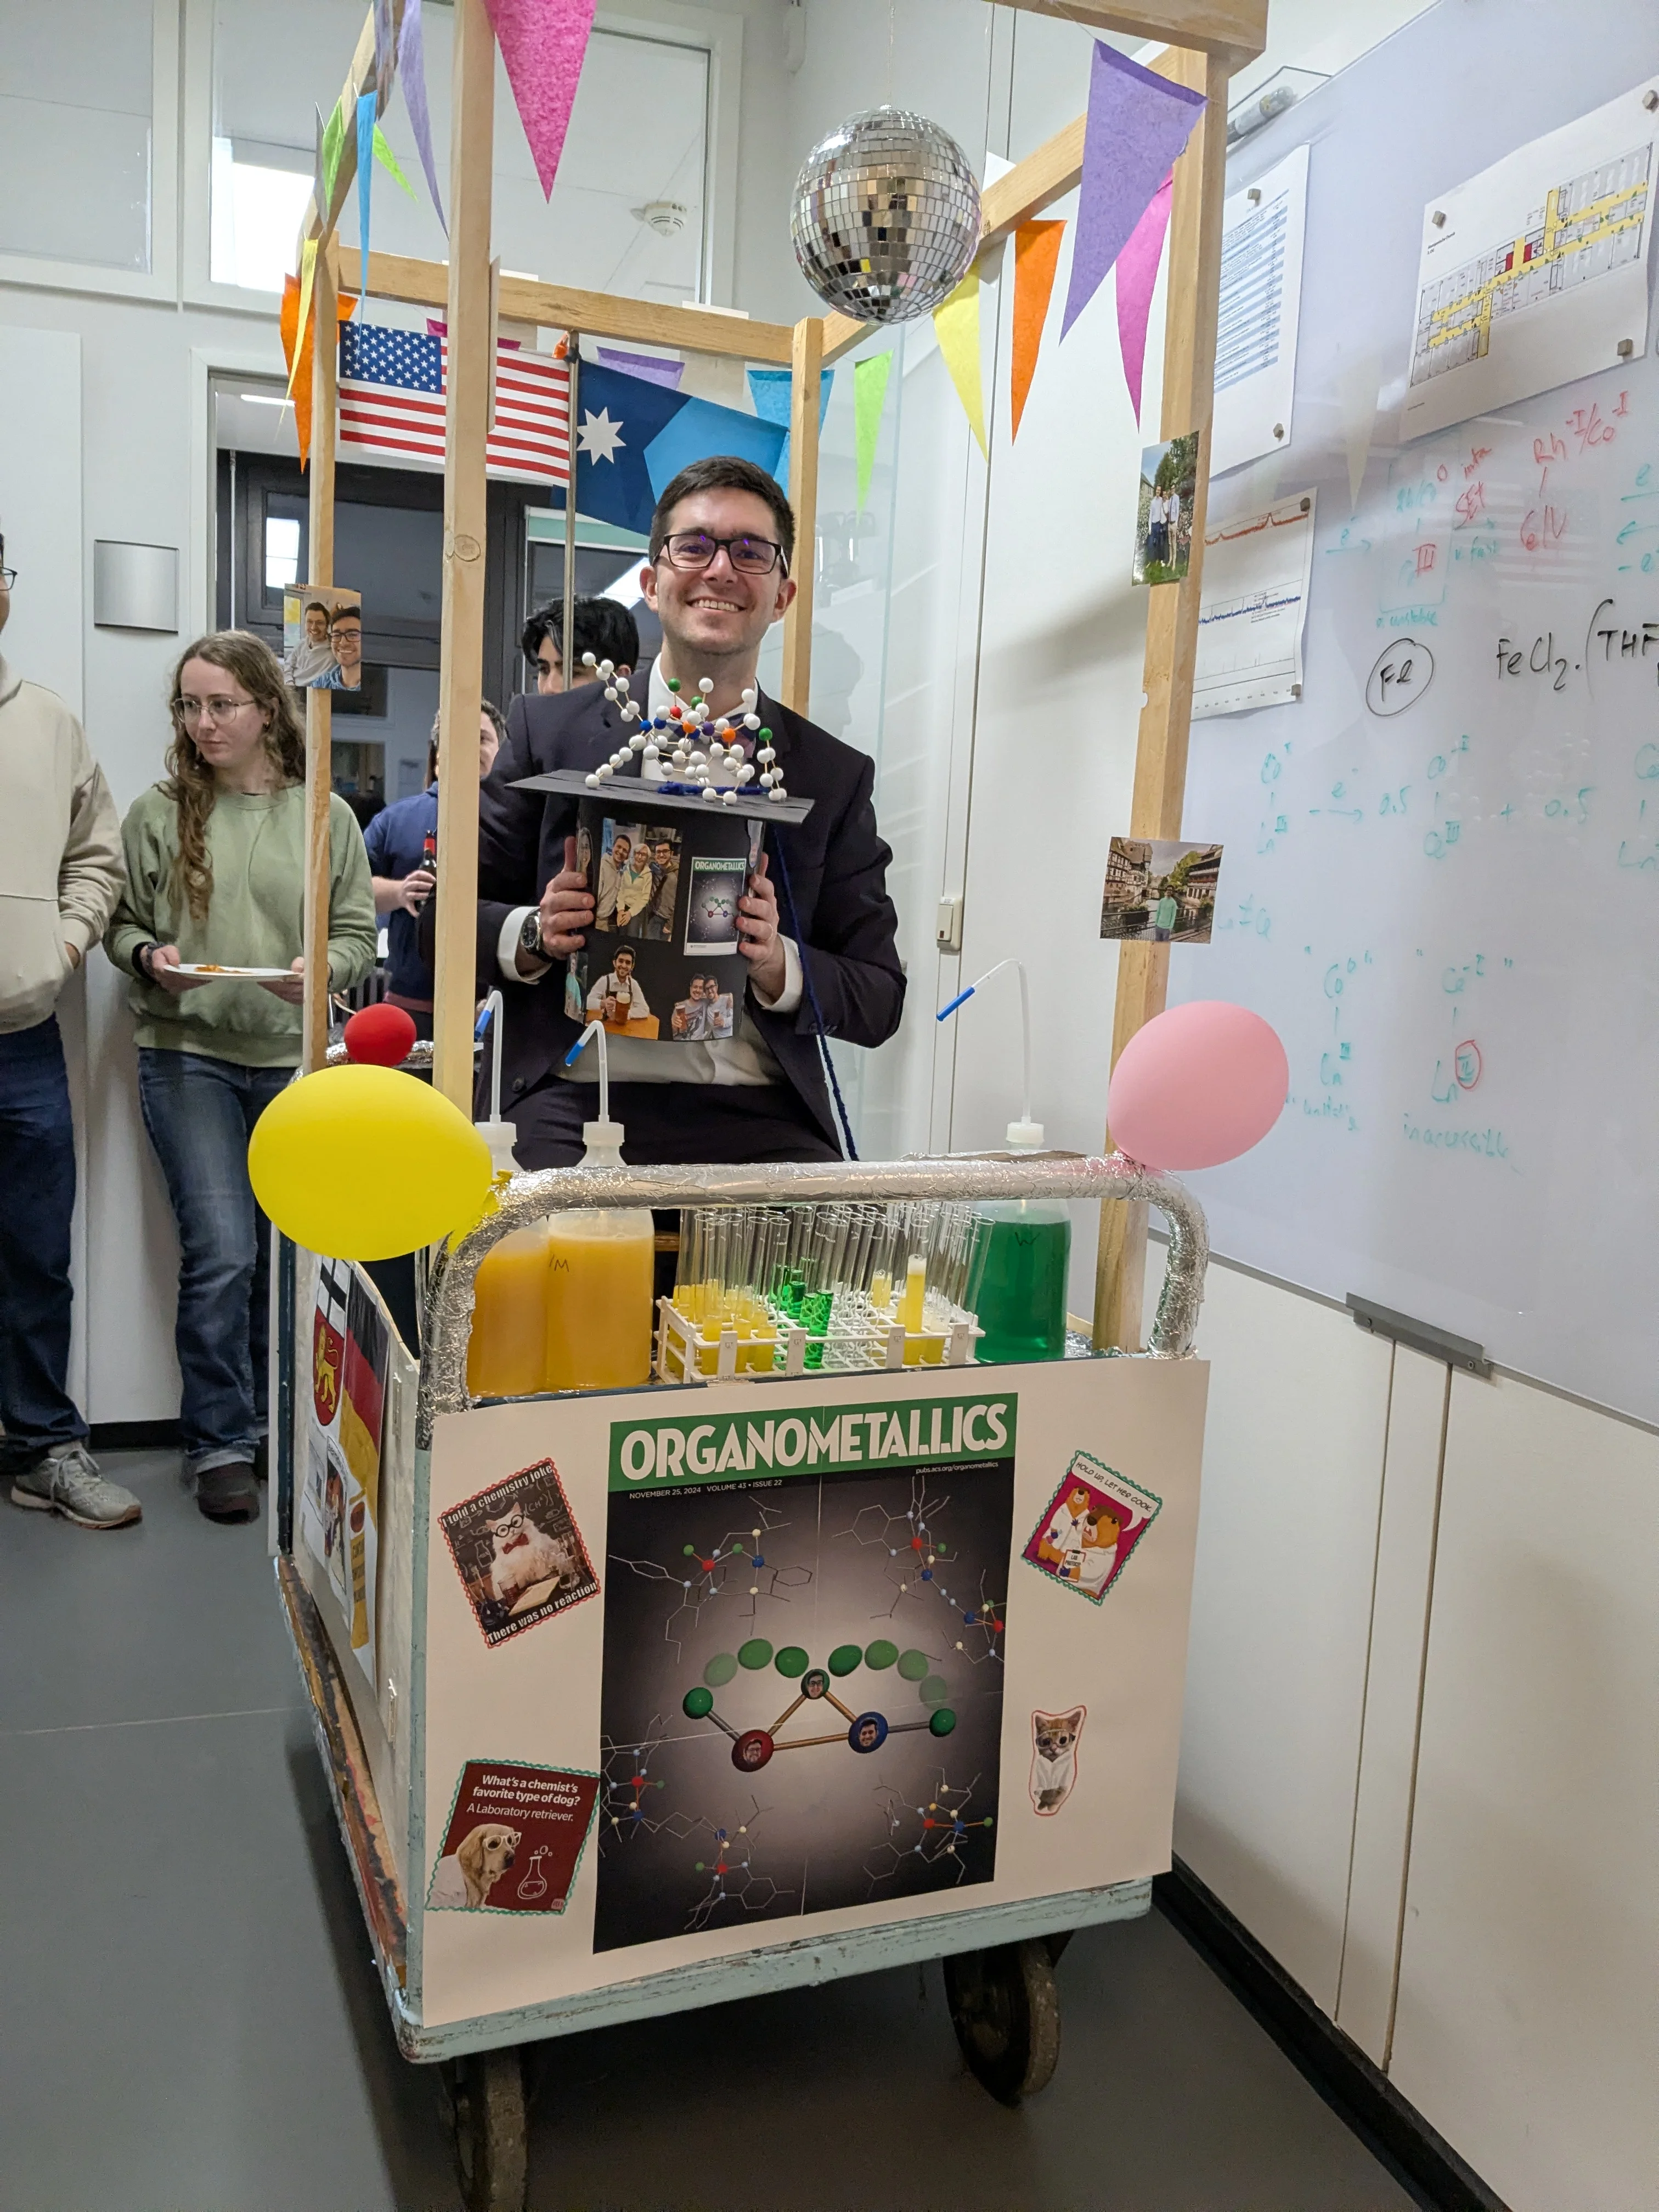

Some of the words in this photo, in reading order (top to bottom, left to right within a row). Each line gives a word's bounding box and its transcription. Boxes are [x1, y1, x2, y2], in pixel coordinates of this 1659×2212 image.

[695, 861, 744, 871] ORGANOMETALLICS
[620, 1403, 1008, 1480] ORGANOMETALLICS
[916, 1462, 998, 1474] pubs.acs.org/organometallics
[448, 1505, 469, 1524] told
[470, 1503, 477, 1512] a
[478, 1475, 529, 1508] chemistry
[529, 1465, 553, 1482] joke
[629, 1489, 670, 1499] NOVEMBER
[707, 1483, 736, 1492] VOLUME
[1076, 1462, 1095, 1475] HOLD
[1094, 1472, 1104, 1482] UP,
[1104, 1480, 1119, 1490] LET
[1118, 1487, 1132, 1498] HER
[1130, 1497, 1152, 1513] COOK.
[487, 1623, 517, 1644] There
[517, 1611, 539, 1628] was
[540, 1604, 554, 1617] no
[554, 1582, 597, 1610] reaction
[482, 1775, 519, 1787] What's
[527, 1779, 578, 1793] chemist's
[472, 1787, 514, 1799] favorite
[515, 1791, 540, 1802] type
[541, 1792, 554, 1802] of
[552, 1794, 580, 1807] dog?
[466, 1803, 475, 1813] A
[476, 1803, 531, 1819] Laboratory
[531, 1809, 574, 1822] retriever.
